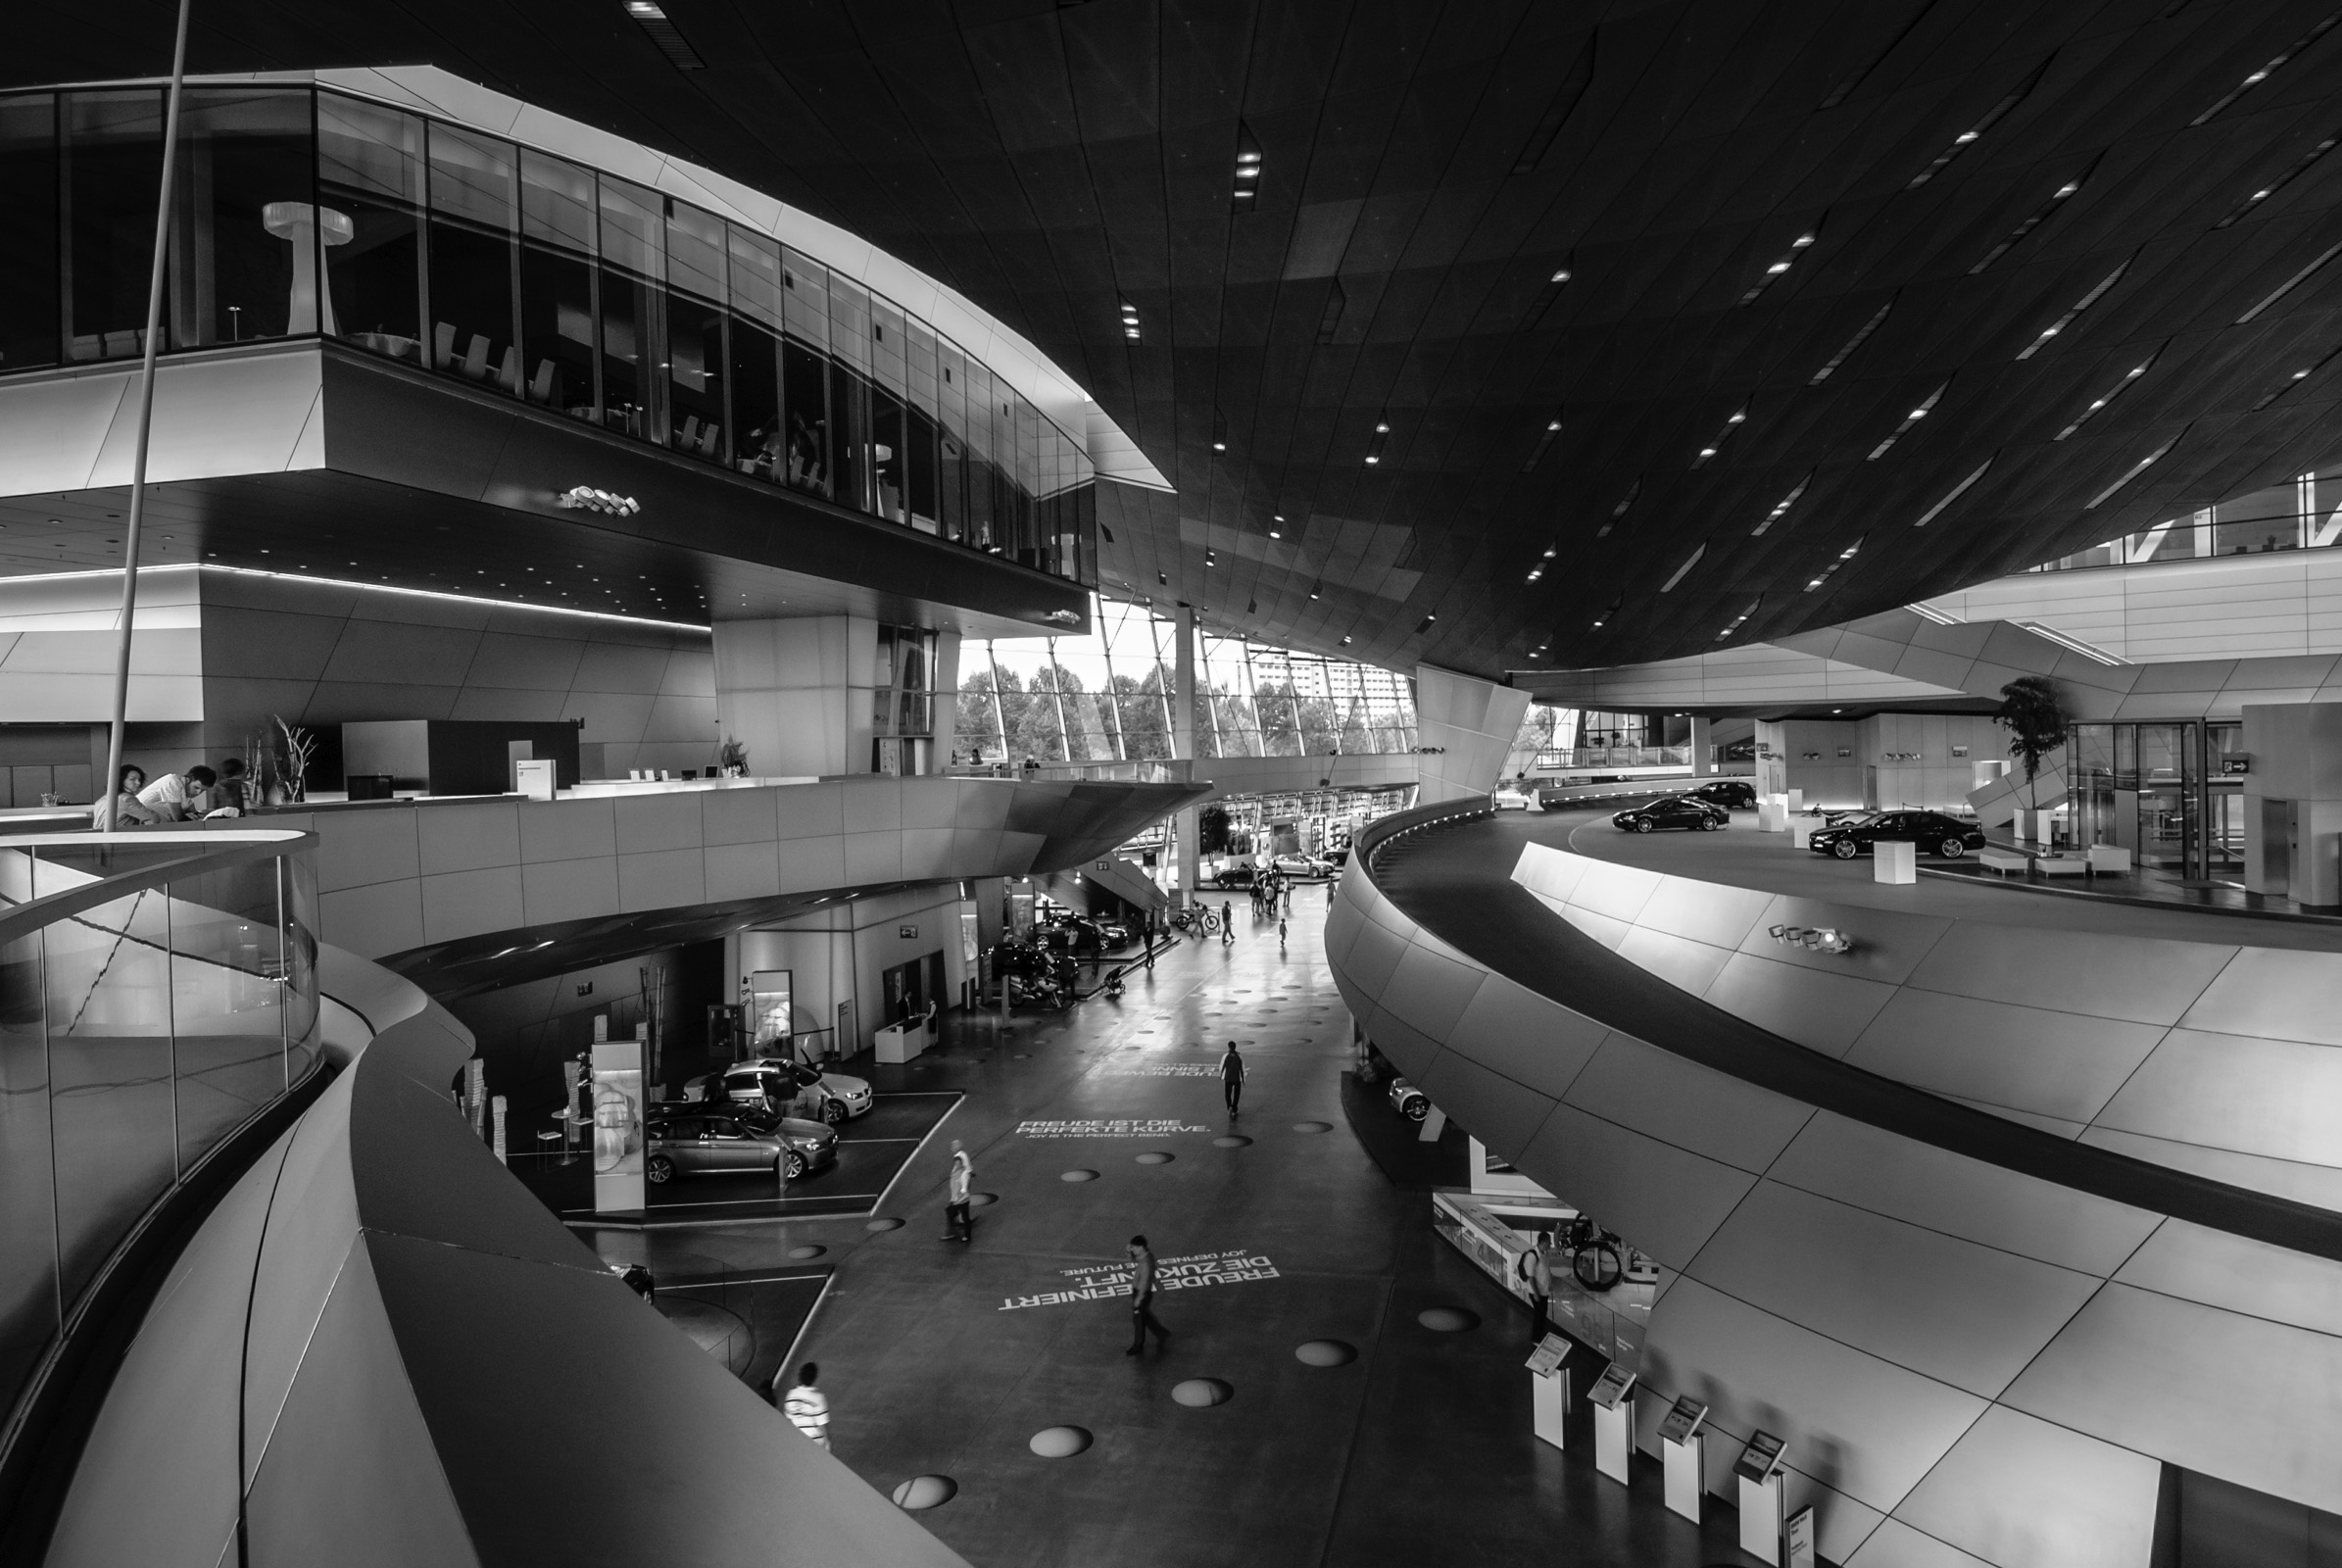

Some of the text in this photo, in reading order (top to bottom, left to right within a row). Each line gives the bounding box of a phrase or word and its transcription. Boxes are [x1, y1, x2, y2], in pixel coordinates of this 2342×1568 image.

[1156, 1252, 1219, 1265] DEFINES
[1221, 1250, 1247, 1258] JOY
[1059, 1263, 1123, 1277] FUTURE.
[1222, 1255, 1272, 1271] DIE
[1160, 1267, 1281, 1291] FREUDE
